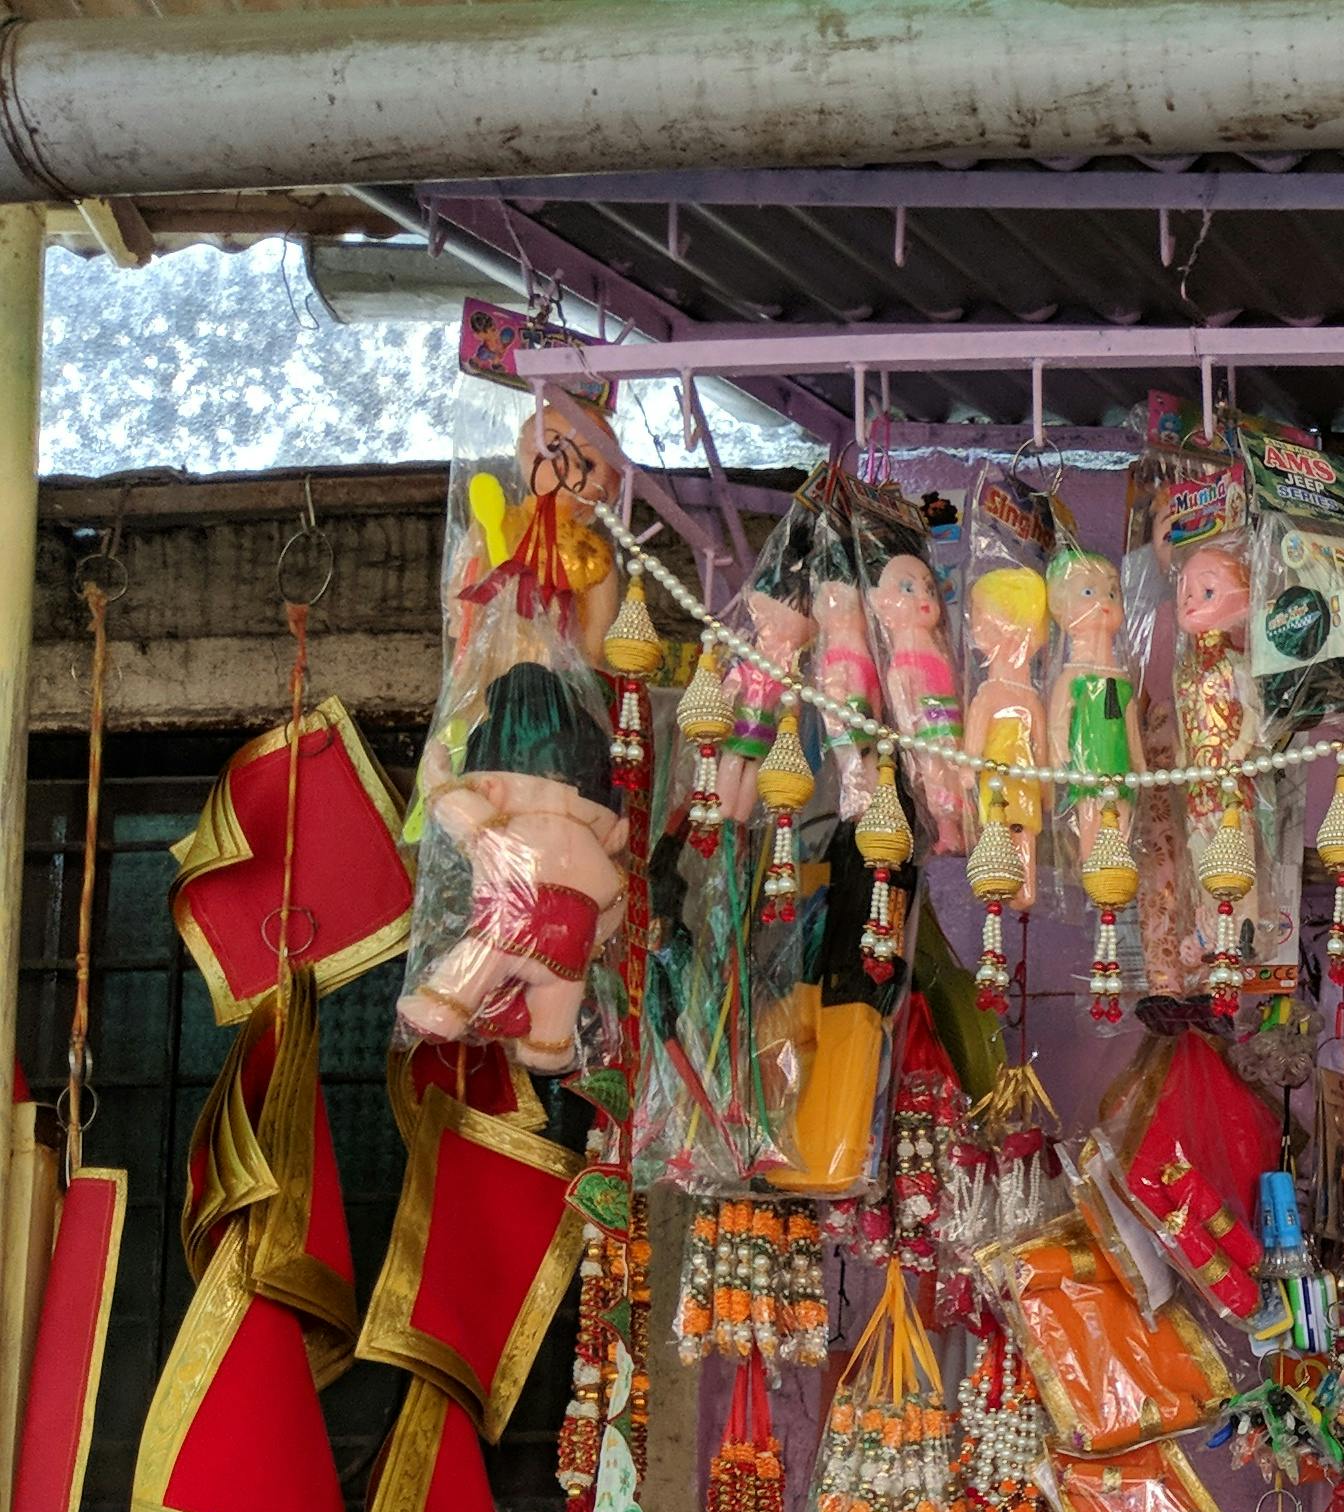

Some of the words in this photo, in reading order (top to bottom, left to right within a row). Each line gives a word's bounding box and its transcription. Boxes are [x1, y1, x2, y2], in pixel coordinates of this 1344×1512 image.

[1264, 446, 1336, 484] AMS
[1284, 473, 1326, 493] JEEP
[1277, 484, 1340, 510] SERIES
